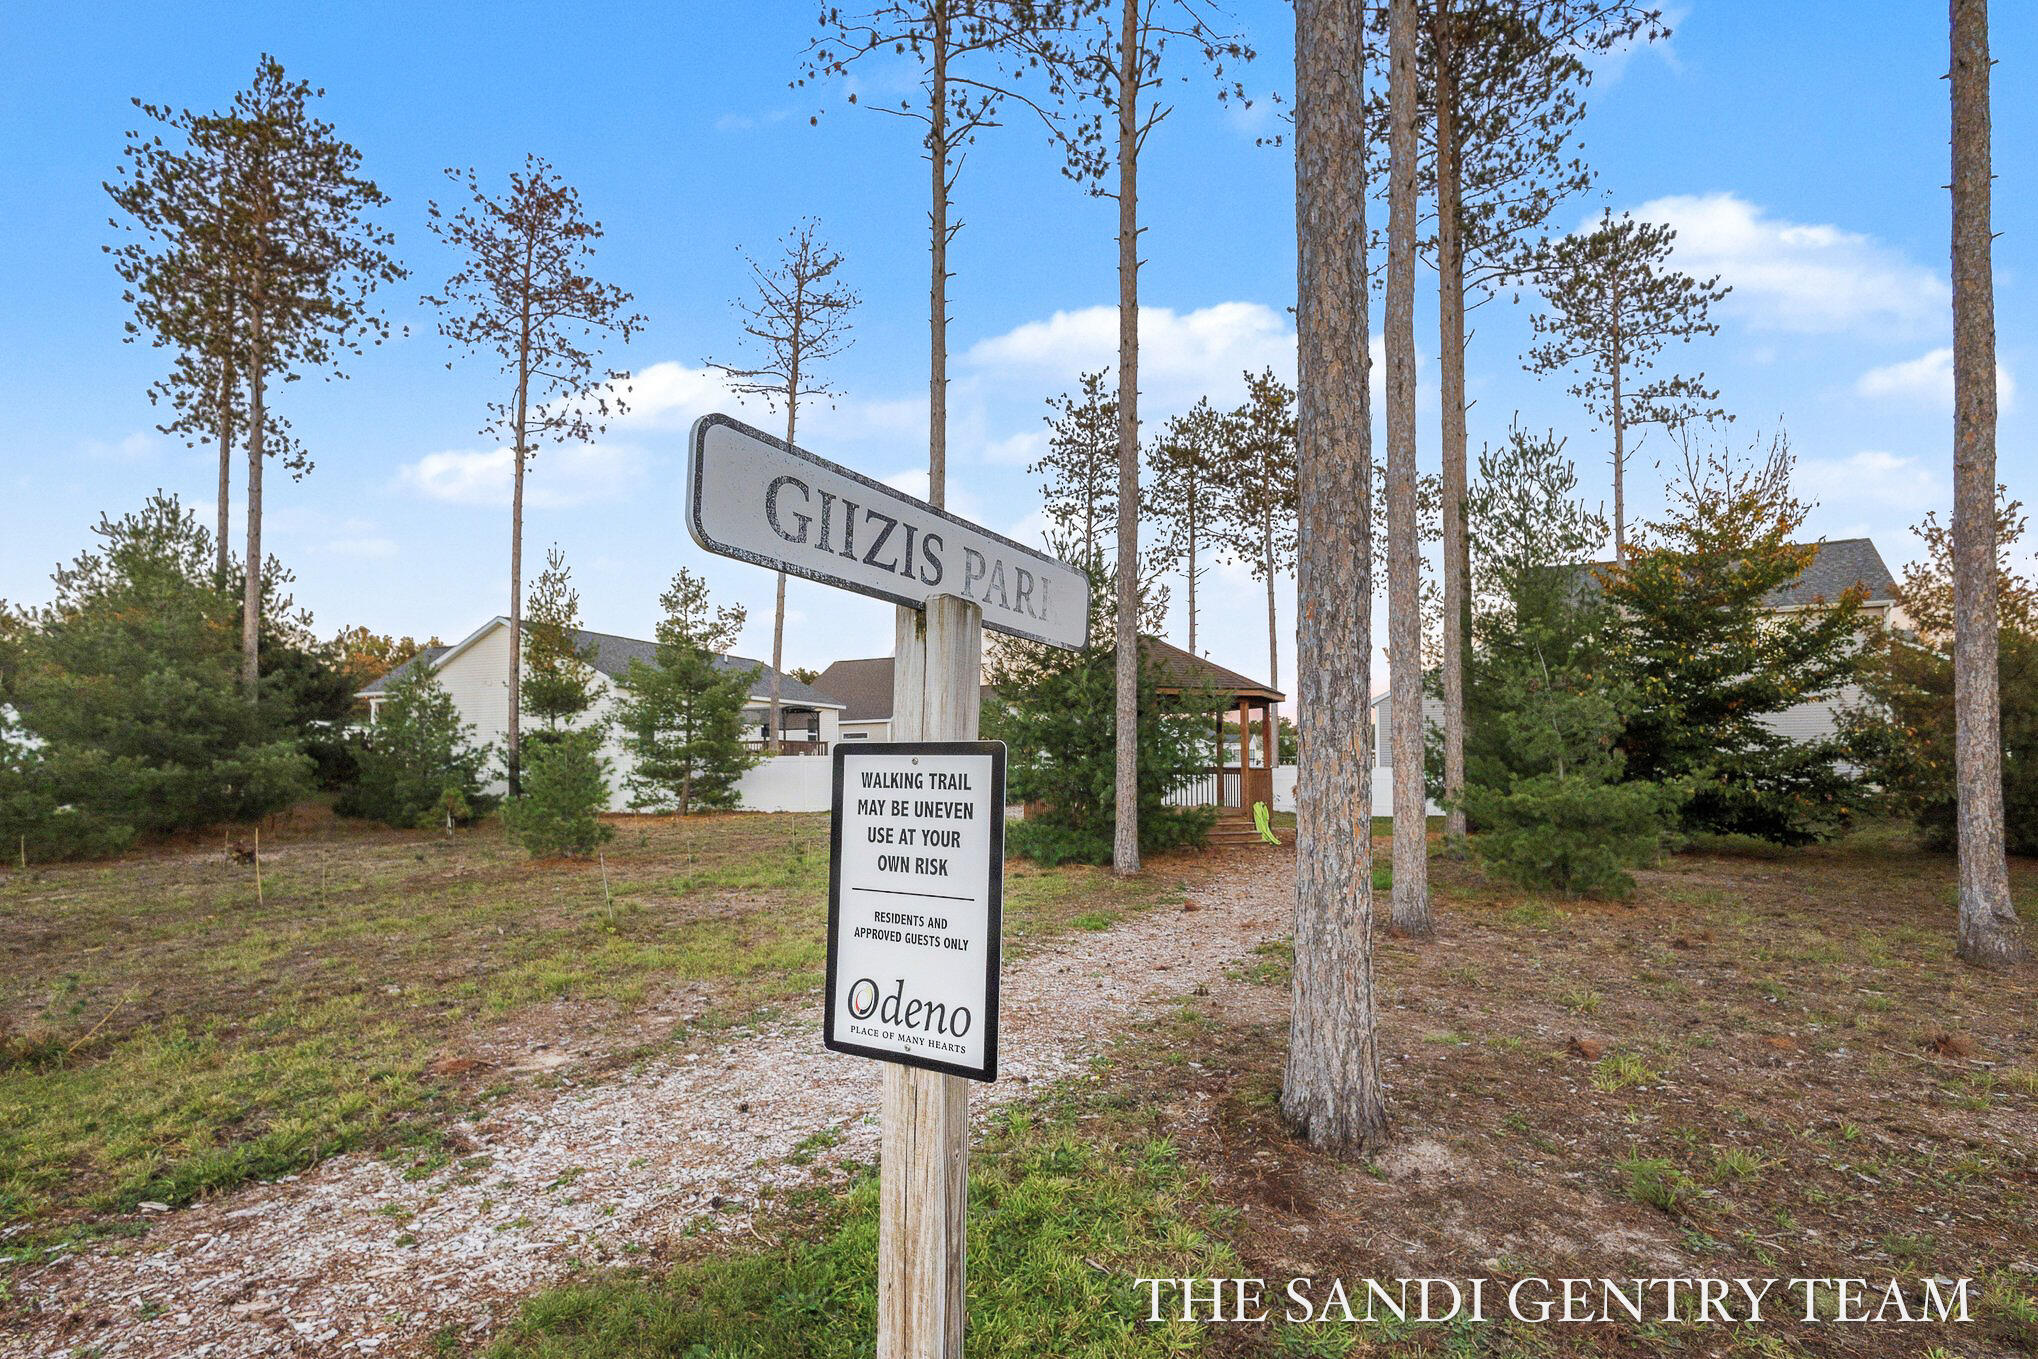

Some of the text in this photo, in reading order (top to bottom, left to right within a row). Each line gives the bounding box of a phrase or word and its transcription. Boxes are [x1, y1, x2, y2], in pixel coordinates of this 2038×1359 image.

[765, 476, 944, 586] GIIZIS
[861, 772, 971, 790] WALKING TRAIL
[858, 799, 974, 819] MAY BE UNEVEN
[867, 827, 960, 848] USE AT YOUR
[878, 855, 948, 876] OWN RISK
[874, 911, 948, 930] RESIDENTS AND
[854, 927, 969, 951] APPROVED GUESTS ONLY
[847, 978, 971, 1038] Odeno
[850, 1025, 966, 1053] PLACE OF MANY HEARTS
